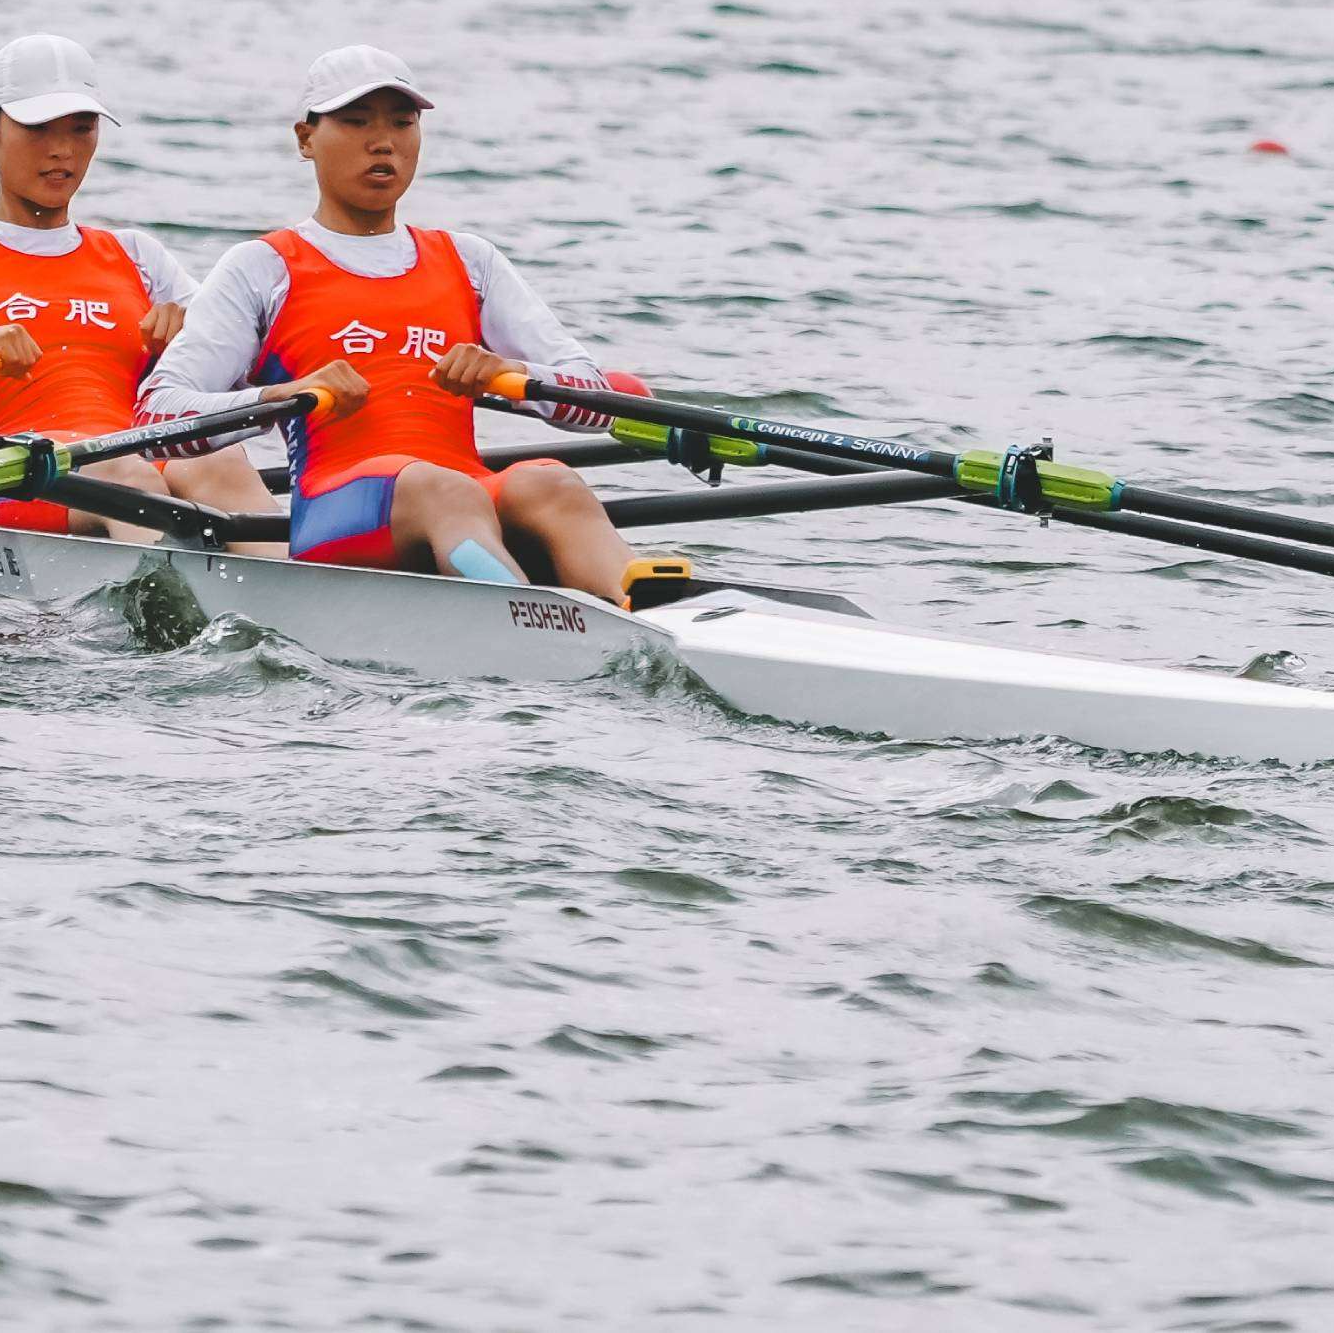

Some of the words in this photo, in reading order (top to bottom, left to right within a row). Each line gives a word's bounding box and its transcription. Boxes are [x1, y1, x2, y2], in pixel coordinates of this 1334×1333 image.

[329, 319, 446, 364] 合肥
[850, 438, 926, 461] SKINNY
[508, 600, 586, 634] PEISHENG
